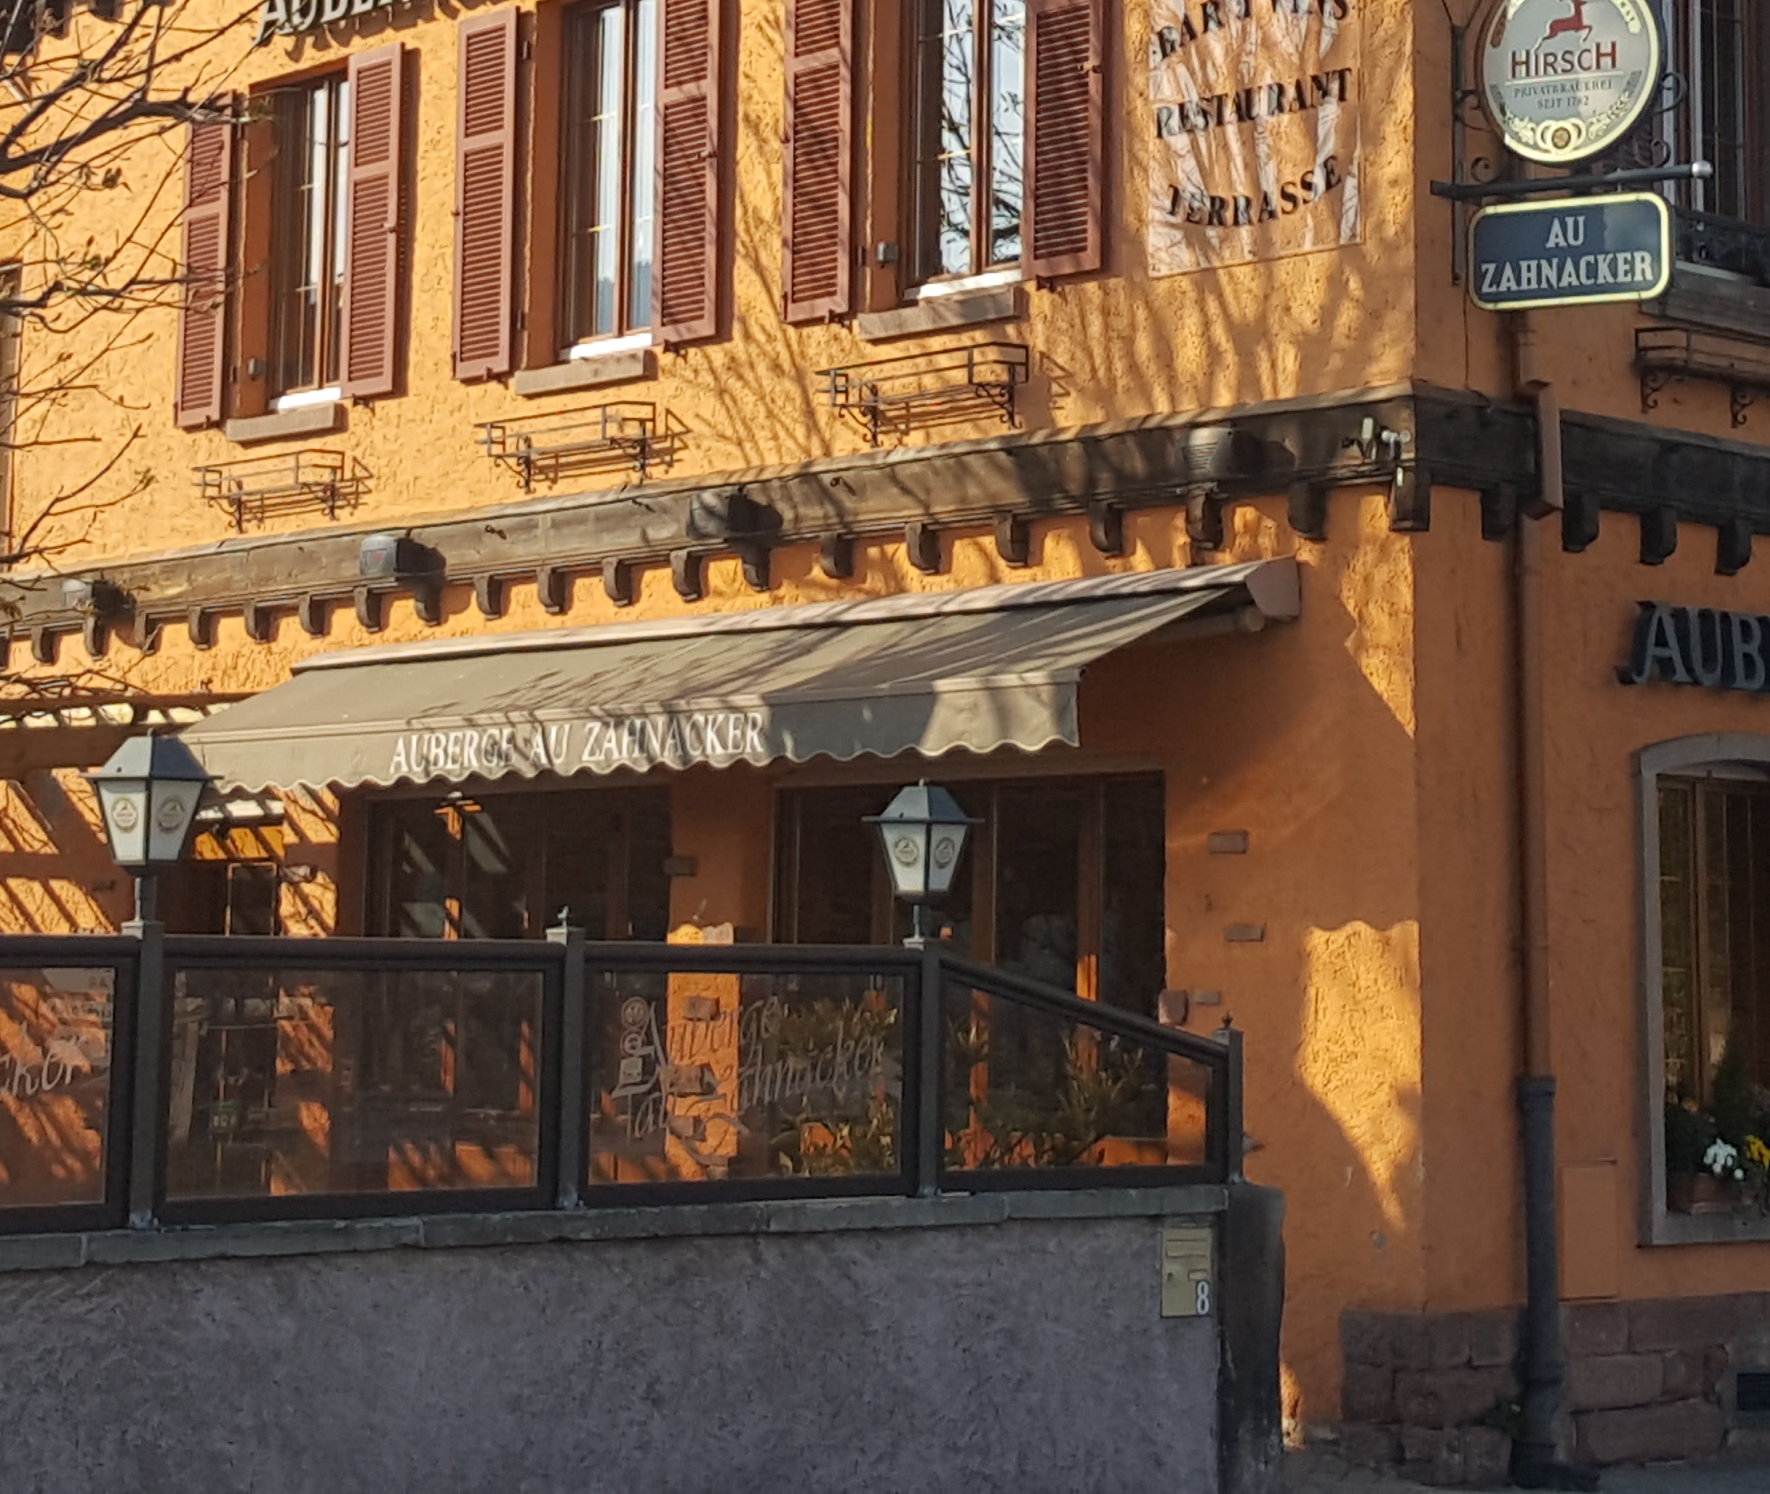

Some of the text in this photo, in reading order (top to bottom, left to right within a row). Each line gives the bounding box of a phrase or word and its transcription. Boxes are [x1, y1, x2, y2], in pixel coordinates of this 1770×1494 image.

[1157, 0, 1225, 60] BAR
[1511, 40, 1617, 79] HIRSCH
[1156, 67, 1353, 138] RESTAURANT
[1166, 155, 1342, 227] TERRASSE
[1546, 216, 1586, 249] AU
[1481, 251, 1654, 294] ZAHNACKER
[389, 711, 765, 774] AUBERGE AU ZAHNACKER
[1197, 1280, 1210, 1315] 8
